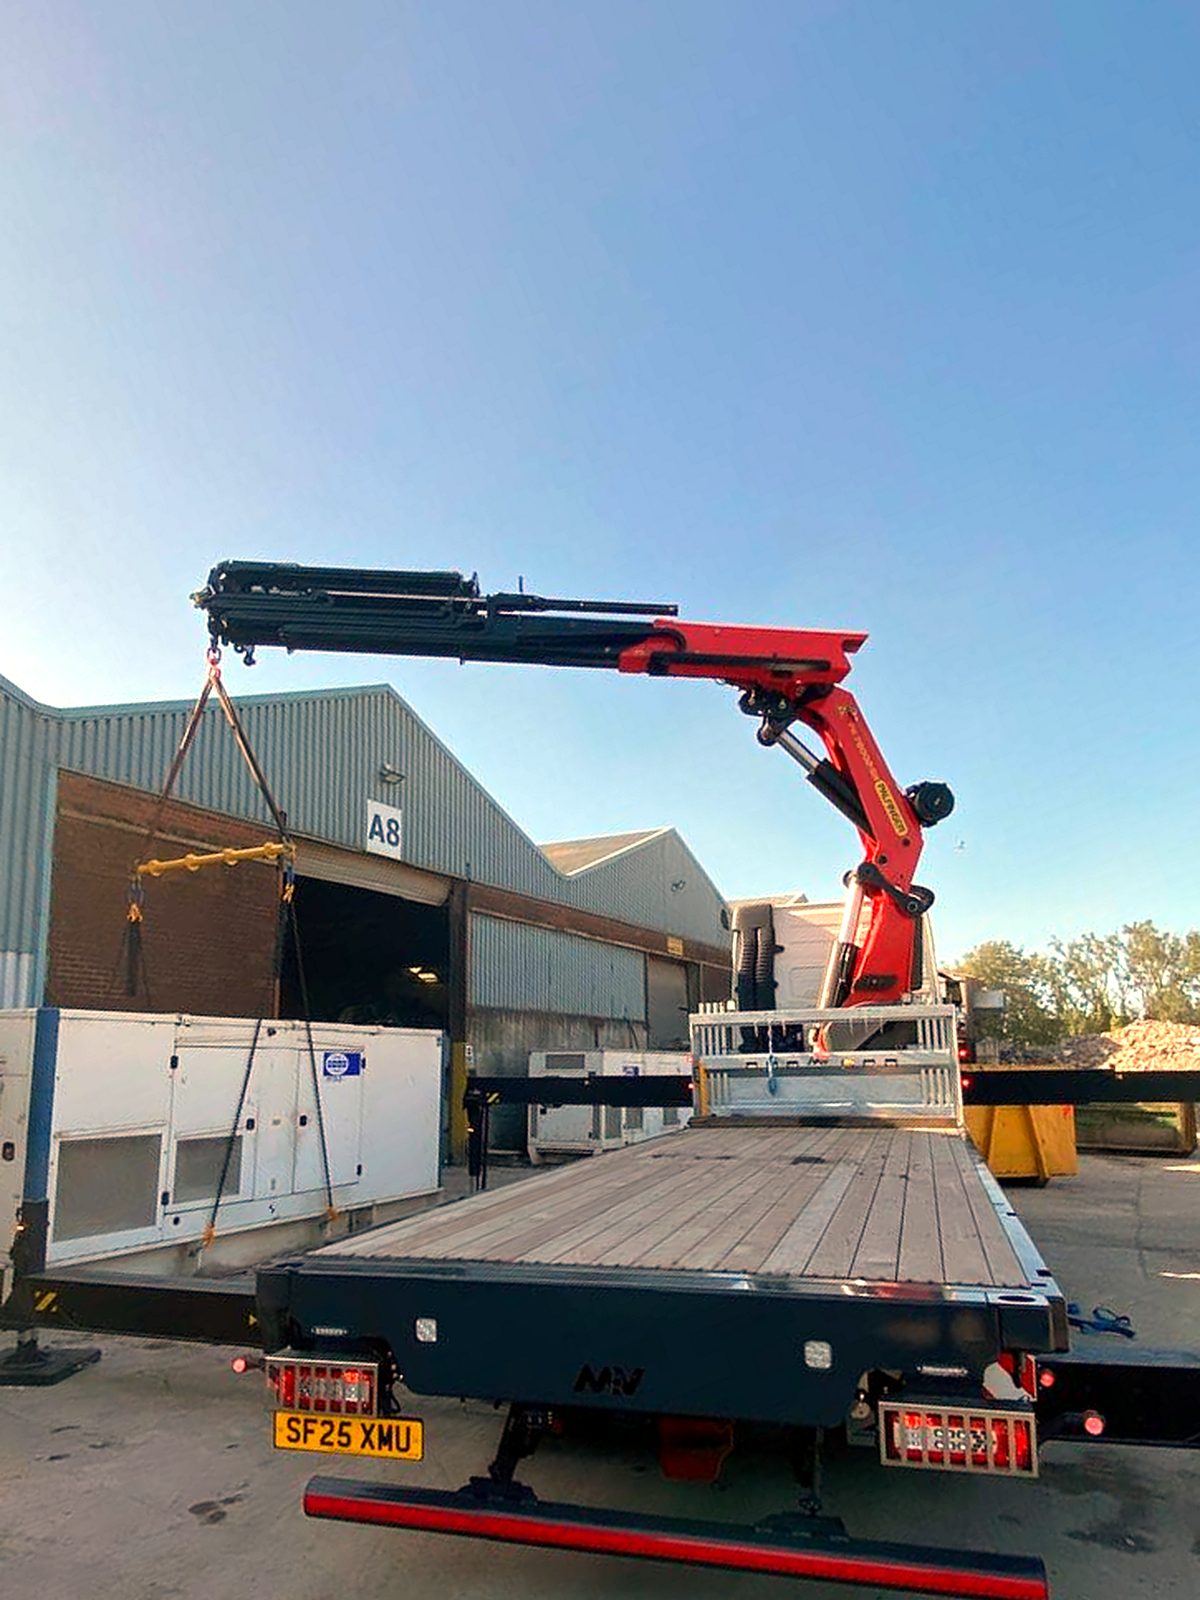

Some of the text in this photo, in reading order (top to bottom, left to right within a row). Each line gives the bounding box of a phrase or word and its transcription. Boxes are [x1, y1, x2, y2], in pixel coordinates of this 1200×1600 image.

[876, 782, 905, 832] PALFINGER
[369, 814, 399, 846] A8
[287, 1417, 411, 1452] SF25 XMU
